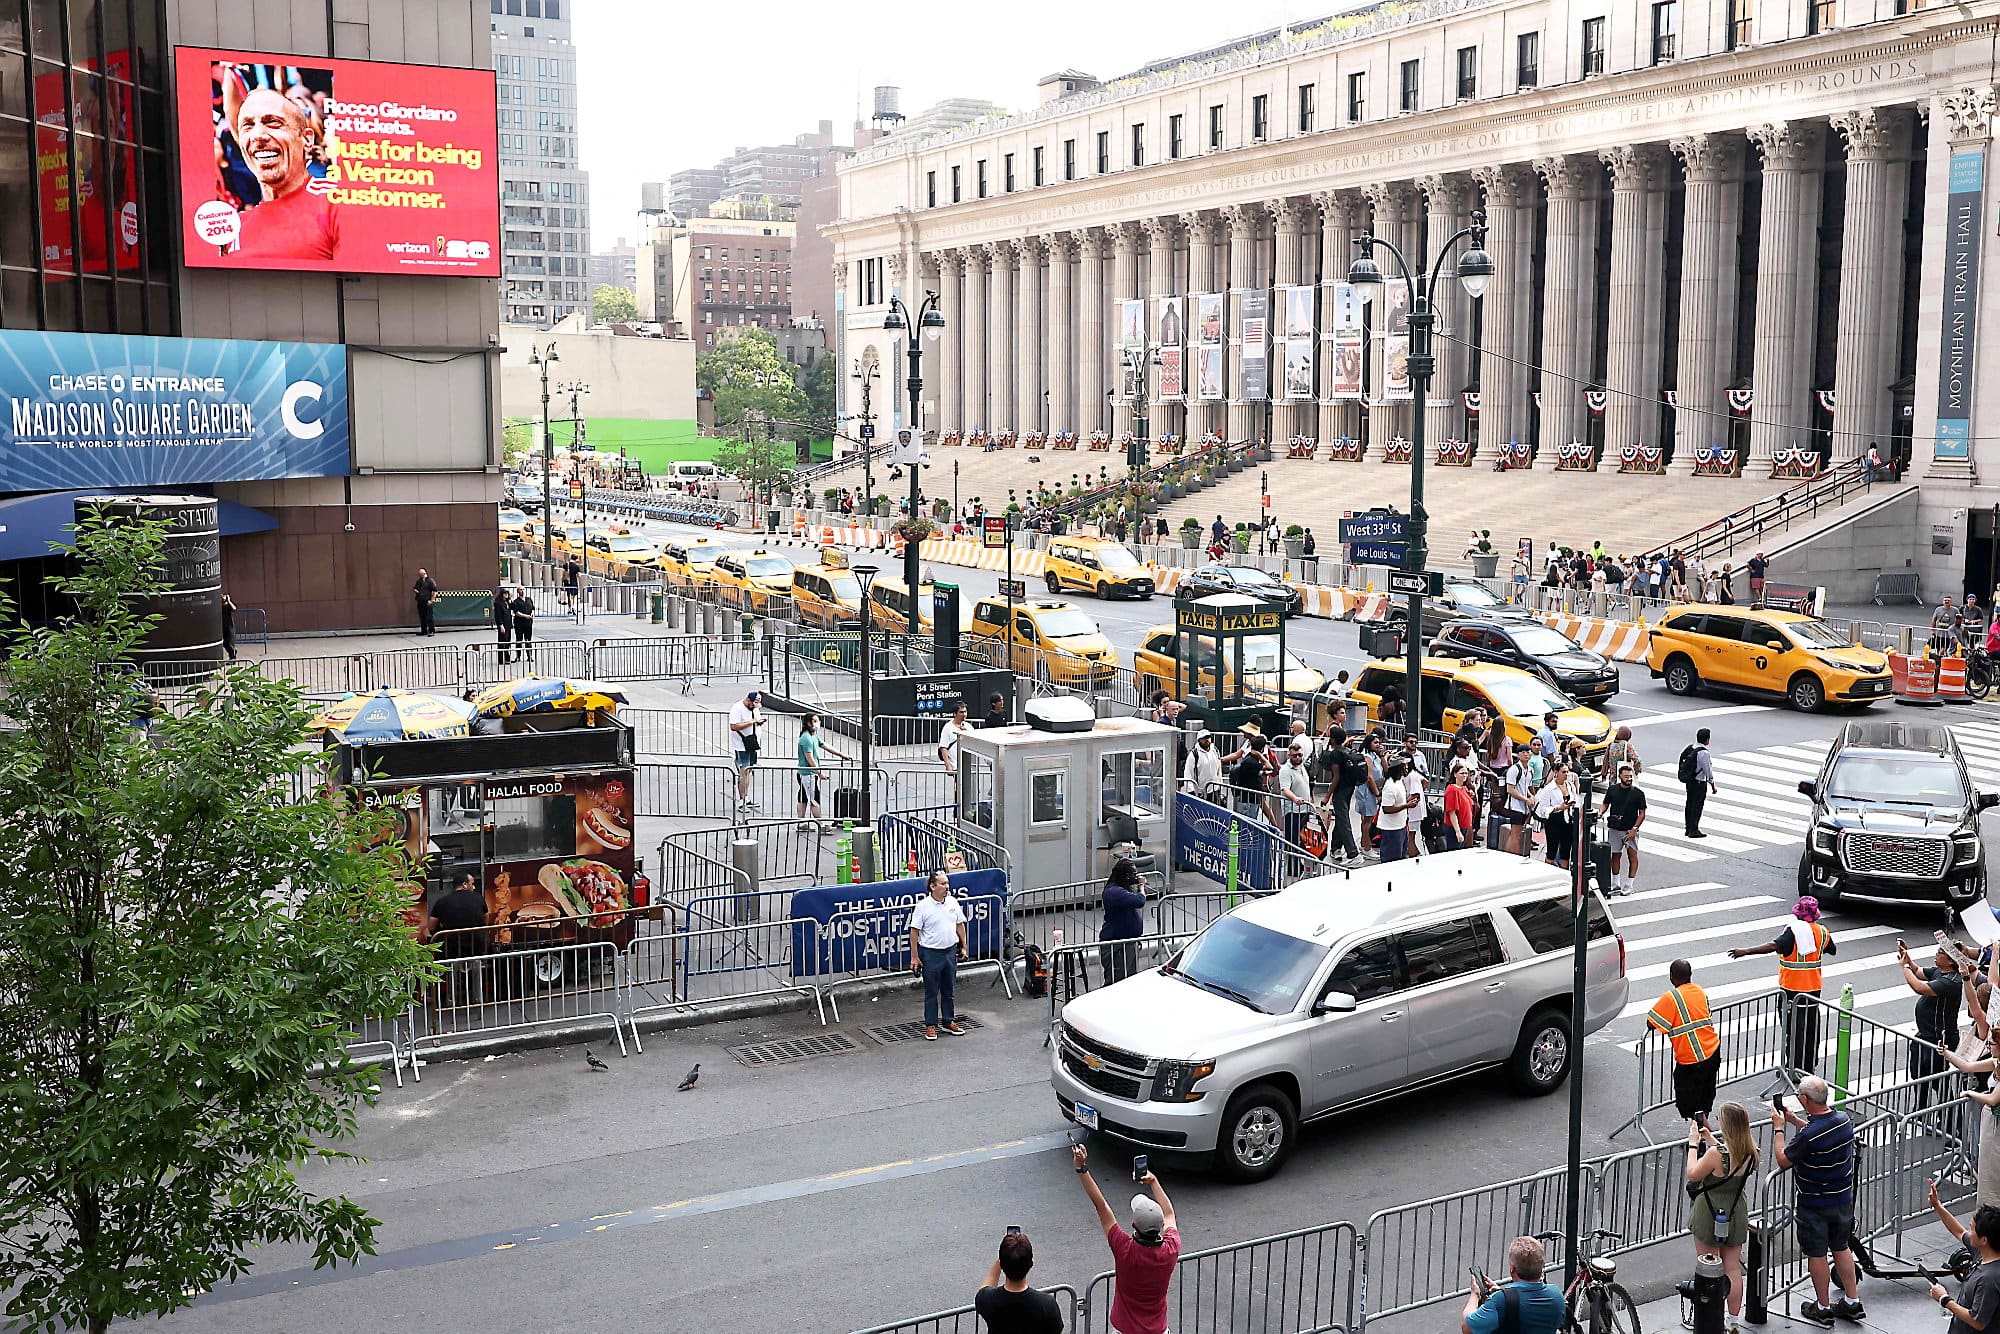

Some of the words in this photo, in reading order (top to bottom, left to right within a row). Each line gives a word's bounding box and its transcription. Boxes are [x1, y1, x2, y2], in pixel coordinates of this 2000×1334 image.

[323, 98, 378, 117] Rocco
[380, 102, 457, 122] Giordano
[324, 115, 354, 134] got
[354, 117, 415, 136] tickets.
[1145, 188, 1177, 203] NIGHT
[1183, 181, 1215, 196] STAYS
[1220, 175, 1256, 190] THESE
[1262, 162, 1328, 184] COURIERS
[1335, 156, 1371, 171] FROM
[1379, 148, 1403, 164] THE
[1413, 140, 1459, 158] SWIFT
[1466, 119, 1577, 149] COMPLETION
[1618, 101, 1676, 122] THEIR
[1686, 79, 1805, 114] APPOINTED
[1817, 57, 1918, 91] ROUNDS
[325, 136, 386, 160] Just
[387, 141, 417, 162] for
[418, 142, 481, 170] being
[327, 165, 341, 181] a
[344, 160, 434, 186] Verizon
[1954, 160, 1979, 170] EMPIRE
[327, 187, 446, 209] customer.
[197, 211, 233, 221] Customer
[1957, 201, 1971, 245] HALL
[206, 224, 233, 237] 2014
[386, 240, 430, 254] verizon
[1954, 252, 1968, 306] TRAIN
[1949, 312, 1964, 410] MOYNIHAN
[50, 374, 108, 391] CHASE
[132, 376, 225, 392] ENTRANCE
[12, 397, 107, 437] MADISON
[113, 397, 182, 438] SQUARE
[280, 380, 326, 440] C
[55, 441, 75, 450] THE
[78, 440, 123, 449] WORLD'S
[126, 440, 152, 448] MOST
[155, 439, 191, 447] FAMOUS
[178, 507, 217, 528] STATION
[1346, 524, 1371, 537] West
[1373, 522, 1390, 536] 33rd
[1392, 523, 1402, 535] St
[1357, 546, 1368, 558] Joe
[1370, 547, 1388, 560] Louis
[1396, 577, 1407, 588] ONE
[1411, 579, 1424, 588] WAY
[1181, 611, 1205, 627] TAXI
[1223, 614, 1260, 629] TAXI
[916, 683, 927, 692] 34
[930, 682, 951, 691] Street
[916, 693, 935, 701] Penn
[936, 691, 962, 699] Station
[487, 784, 527, 799] HALAL
[529, 782, 563, 795] FOOD
[1194, 838, 1228, 861] WELCOME
[1874, 841, 1917, 853] GMC
[1183, 845, 1202, 867] THE
[834, 899, 875, 914] THE
